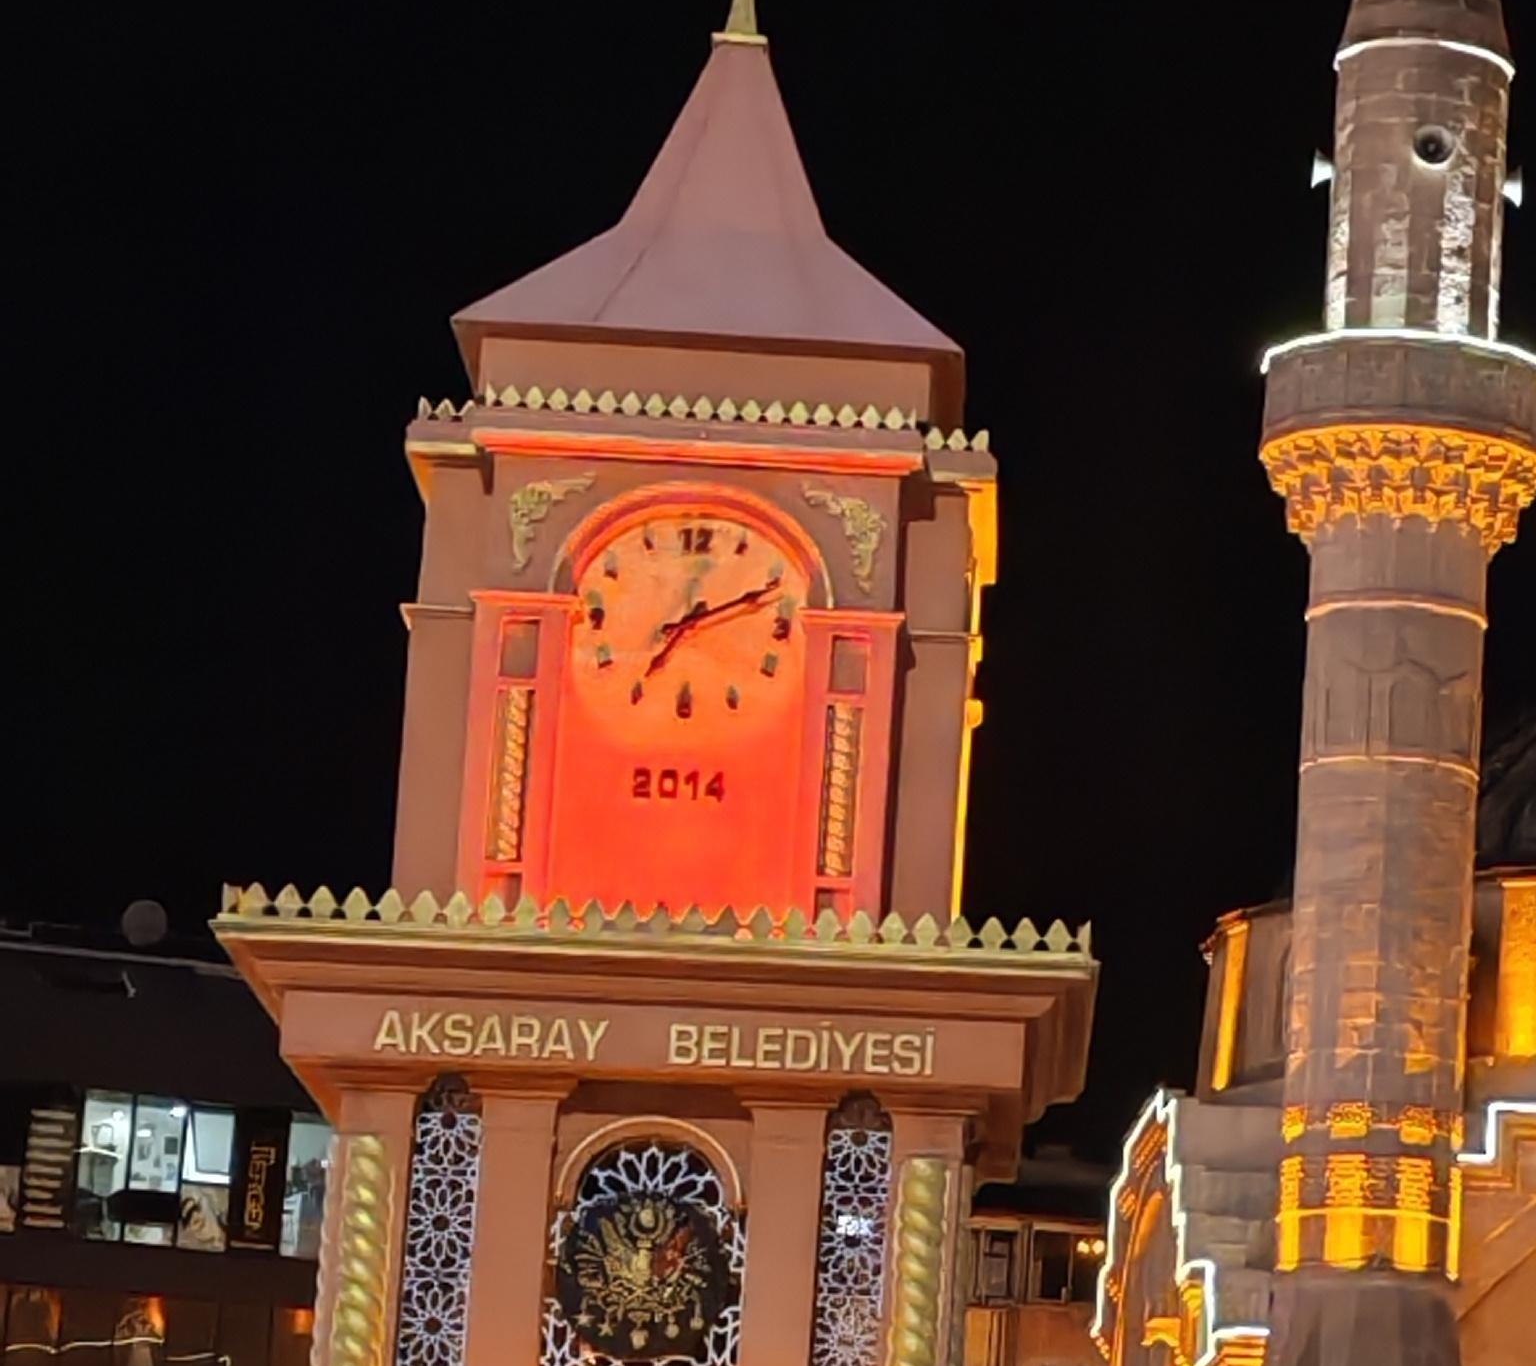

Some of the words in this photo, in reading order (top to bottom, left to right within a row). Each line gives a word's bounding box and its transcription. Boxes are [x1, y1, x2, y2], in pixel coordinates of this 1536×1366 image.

[677, 527, 714, 555] 12
[632, 767, 725, 803] 2014
[373, 1009, 610, 1062] AKSARAY
[667, 1020, 936, 1076] BELEDİYESİ
